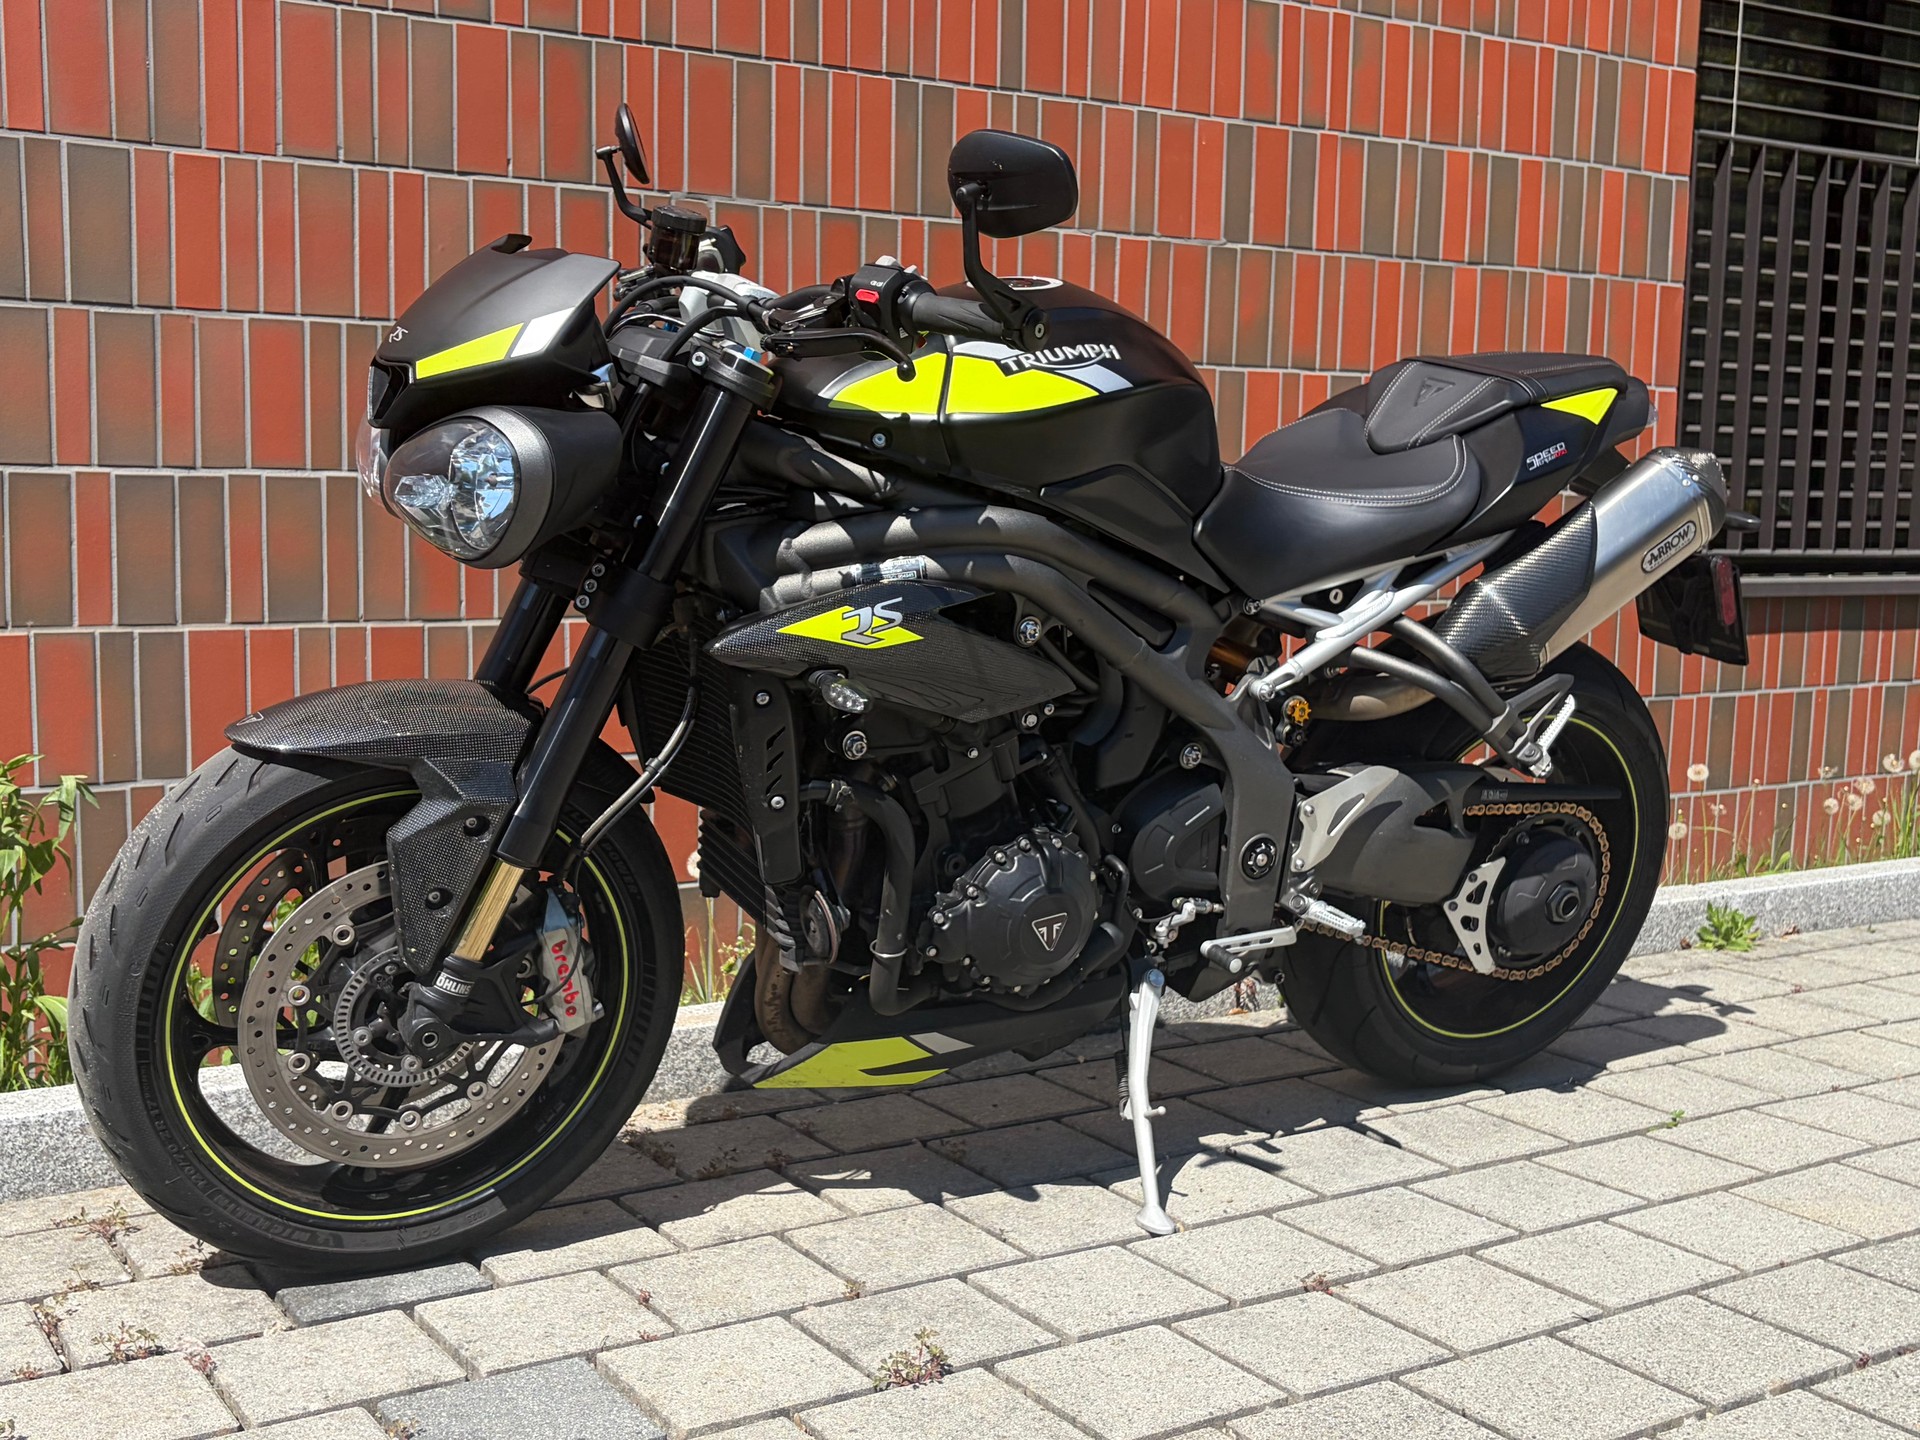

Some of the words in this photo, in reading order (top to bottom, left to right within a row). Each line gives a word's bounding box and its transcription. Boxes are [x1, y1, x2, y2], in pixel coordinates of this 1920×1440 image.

[1001, 343, 1121, 372] TRIUMPH
[1526, 441, 1566, 471] SPEED
[1648, 525, 1691, 566] ARROW
[841, 597, 903, 645] RS
[436, 973, 472, 995] ÖHLINS
